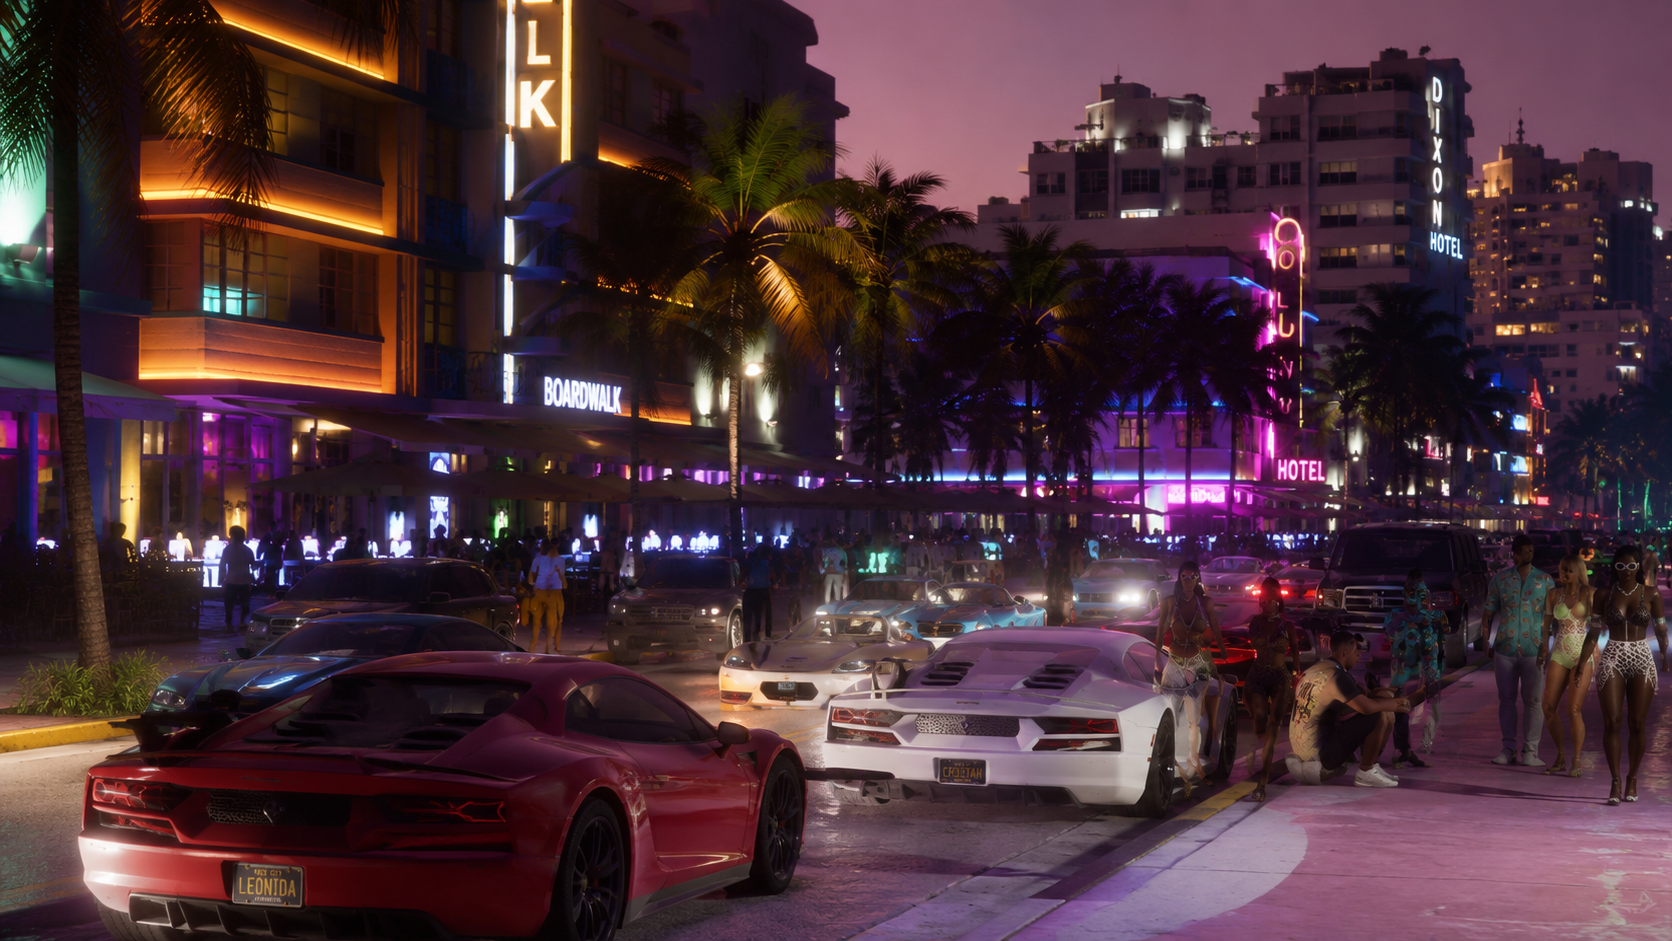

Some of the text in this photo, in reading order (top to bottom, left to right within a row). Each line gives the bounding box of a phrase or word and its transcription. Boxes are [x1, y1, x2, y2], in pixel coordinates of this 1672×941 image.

[520, 0, 556, 128] LK
[1432, 76, 1443, 227] DIXON
[1430, 231, 1463, 260] HOTEL
[544, 376, 622, 414] BOARDWALK
[1277, 459, 1326, 481] HOTEL
[238, 876, 296, 898] LEONIDA
